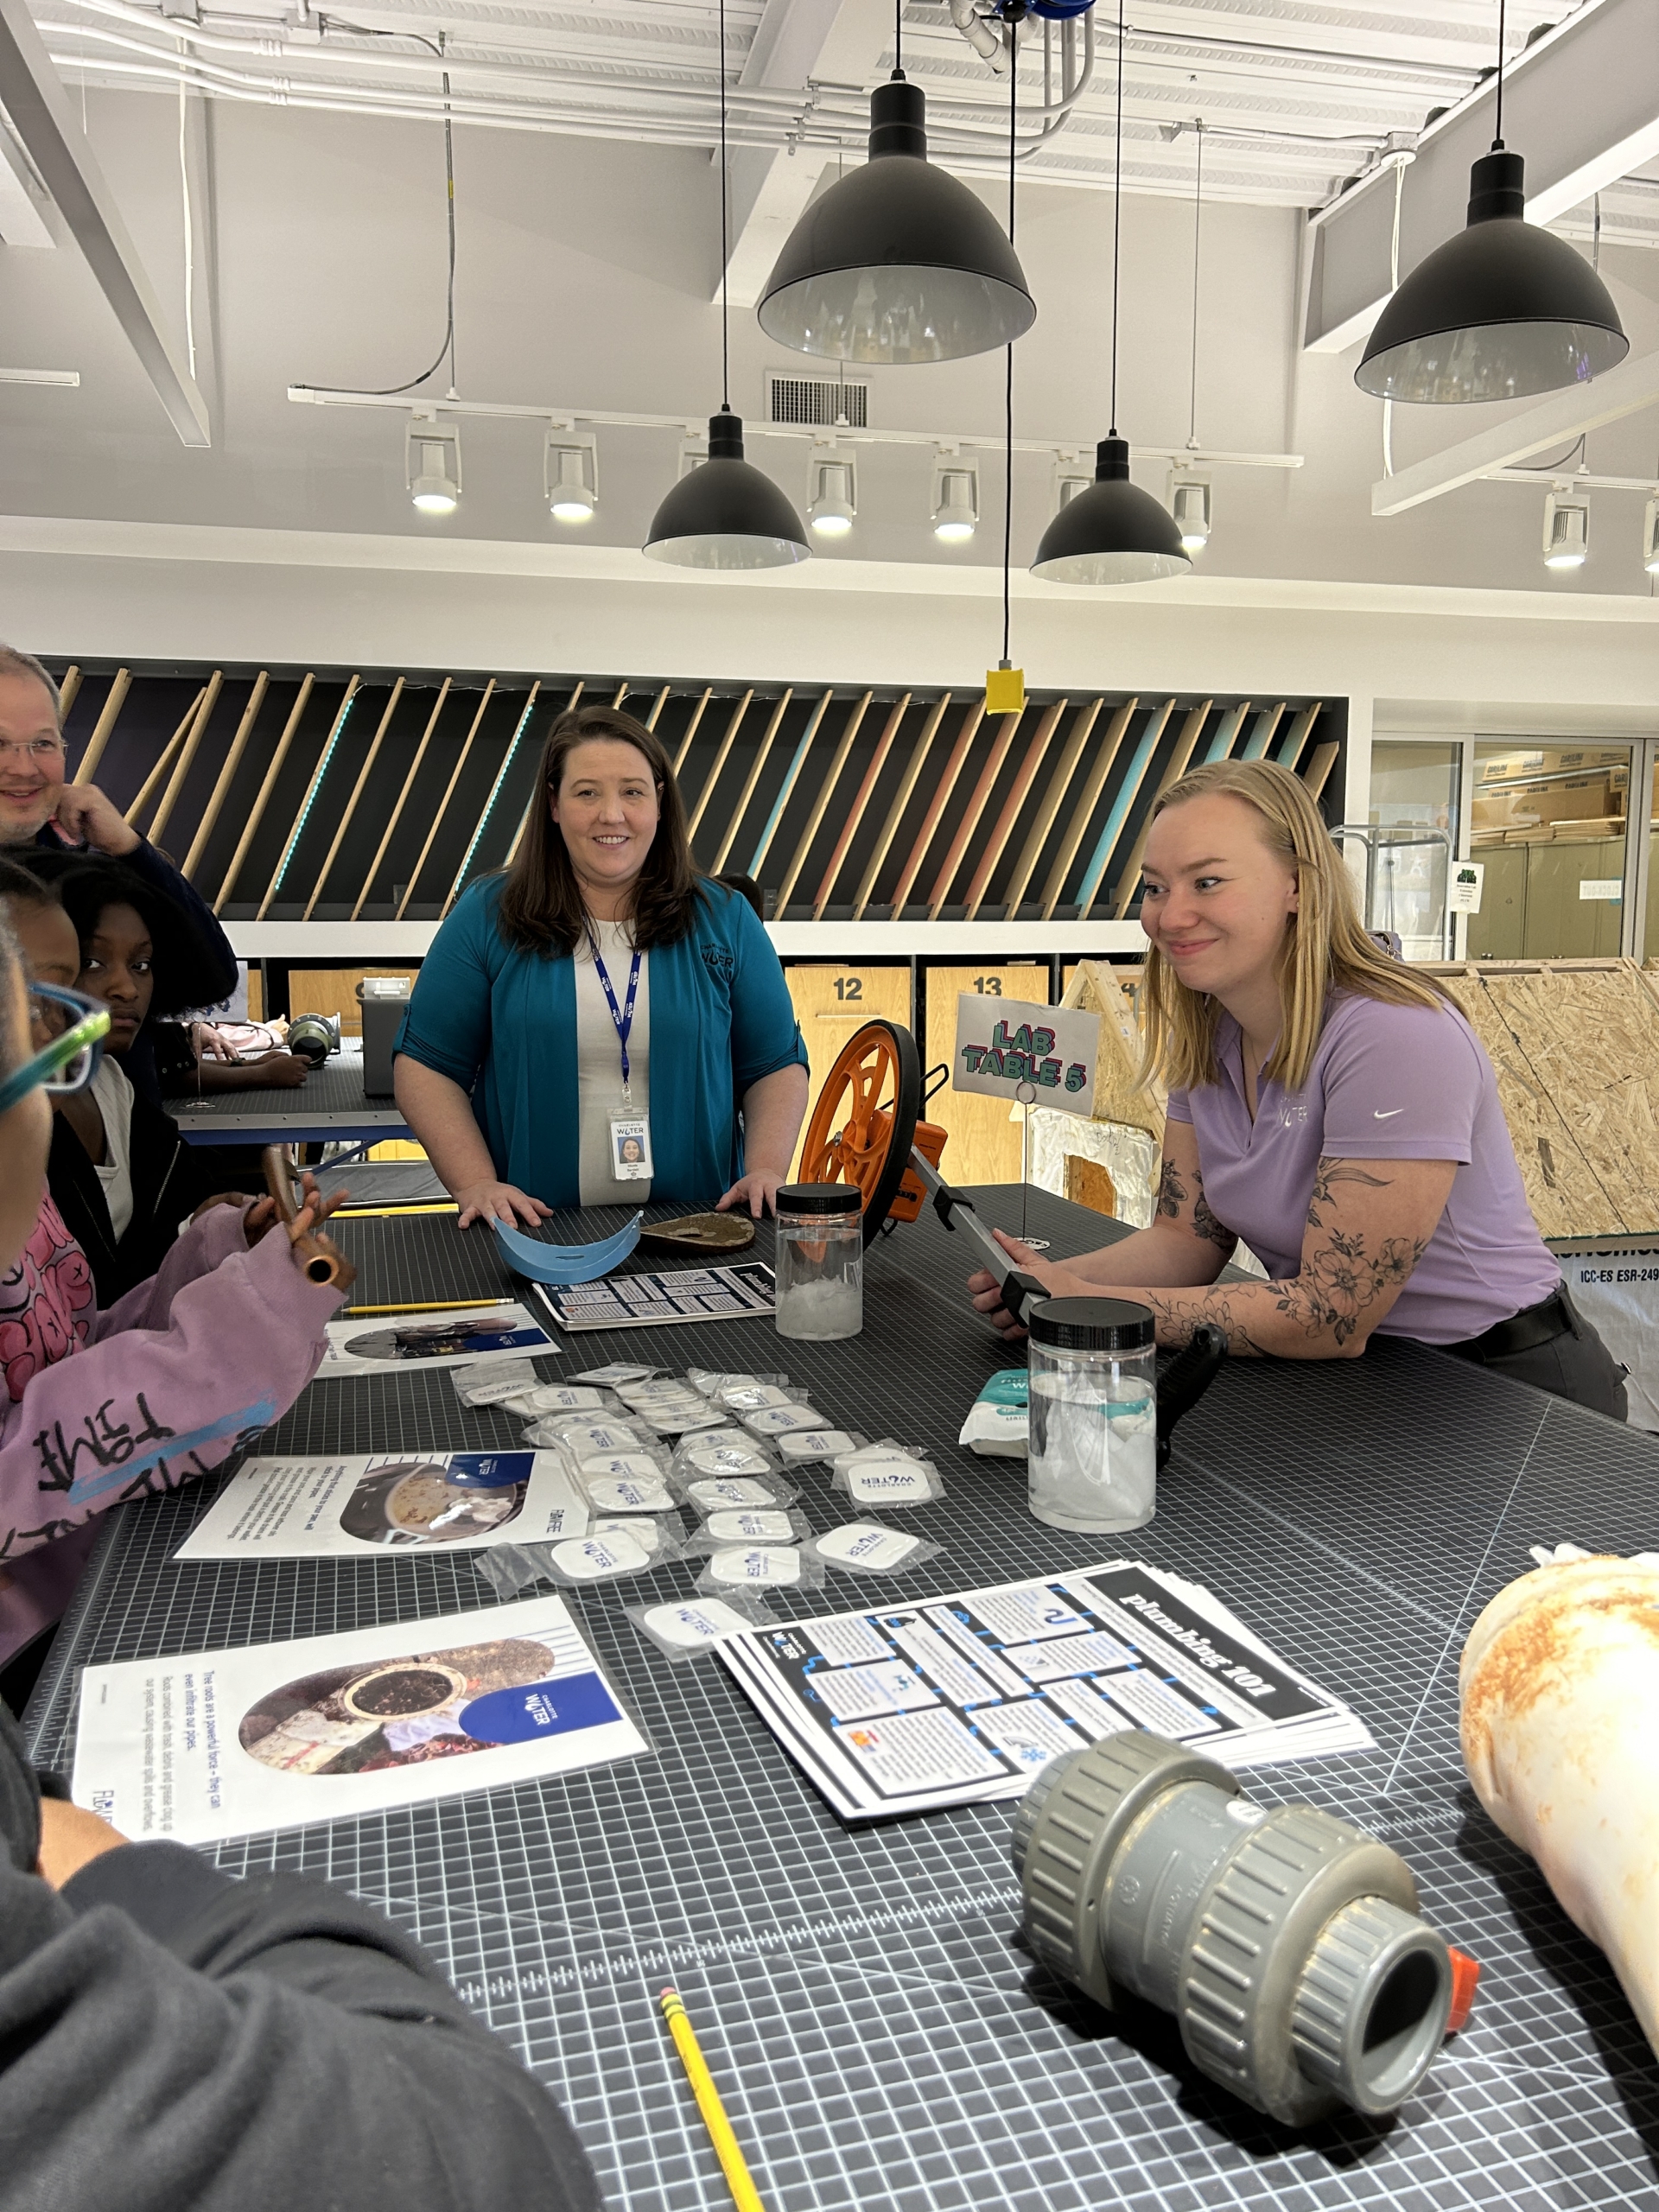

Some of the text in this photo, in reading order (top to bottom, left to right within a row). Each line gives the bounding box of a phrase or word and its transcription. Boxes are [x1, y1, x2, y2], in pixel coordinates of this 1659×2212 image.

[834, 977, 862, 1000] 12
[973, 976, 1001, 996] 13
[993, 1020, 1055, 1056] LAB
[962, 1044, 1086, 1092] TABLE 5
[1580, 1270, 1614, 1283] ICC-ES
[1119, 1592, 1233, 1669] plumbing
[1221, 1666, 1276, 1697] 101
[185, 1673, 194, 1688] even
[204, 1670, 214, 1684] Tree
[185, 1689, 197, 1715] infiltrate
[205, 1686, 214, 1700] roots
[206, 1702, 214, 1713] are
[184, 1729, 199, 1751] pipes.
[204, 1719, 219, 1750] powerful
[208, 1751, 219, 1769] force
[207, 1777, 220, 1793] they
[211, 1795, 219, 1808] can
